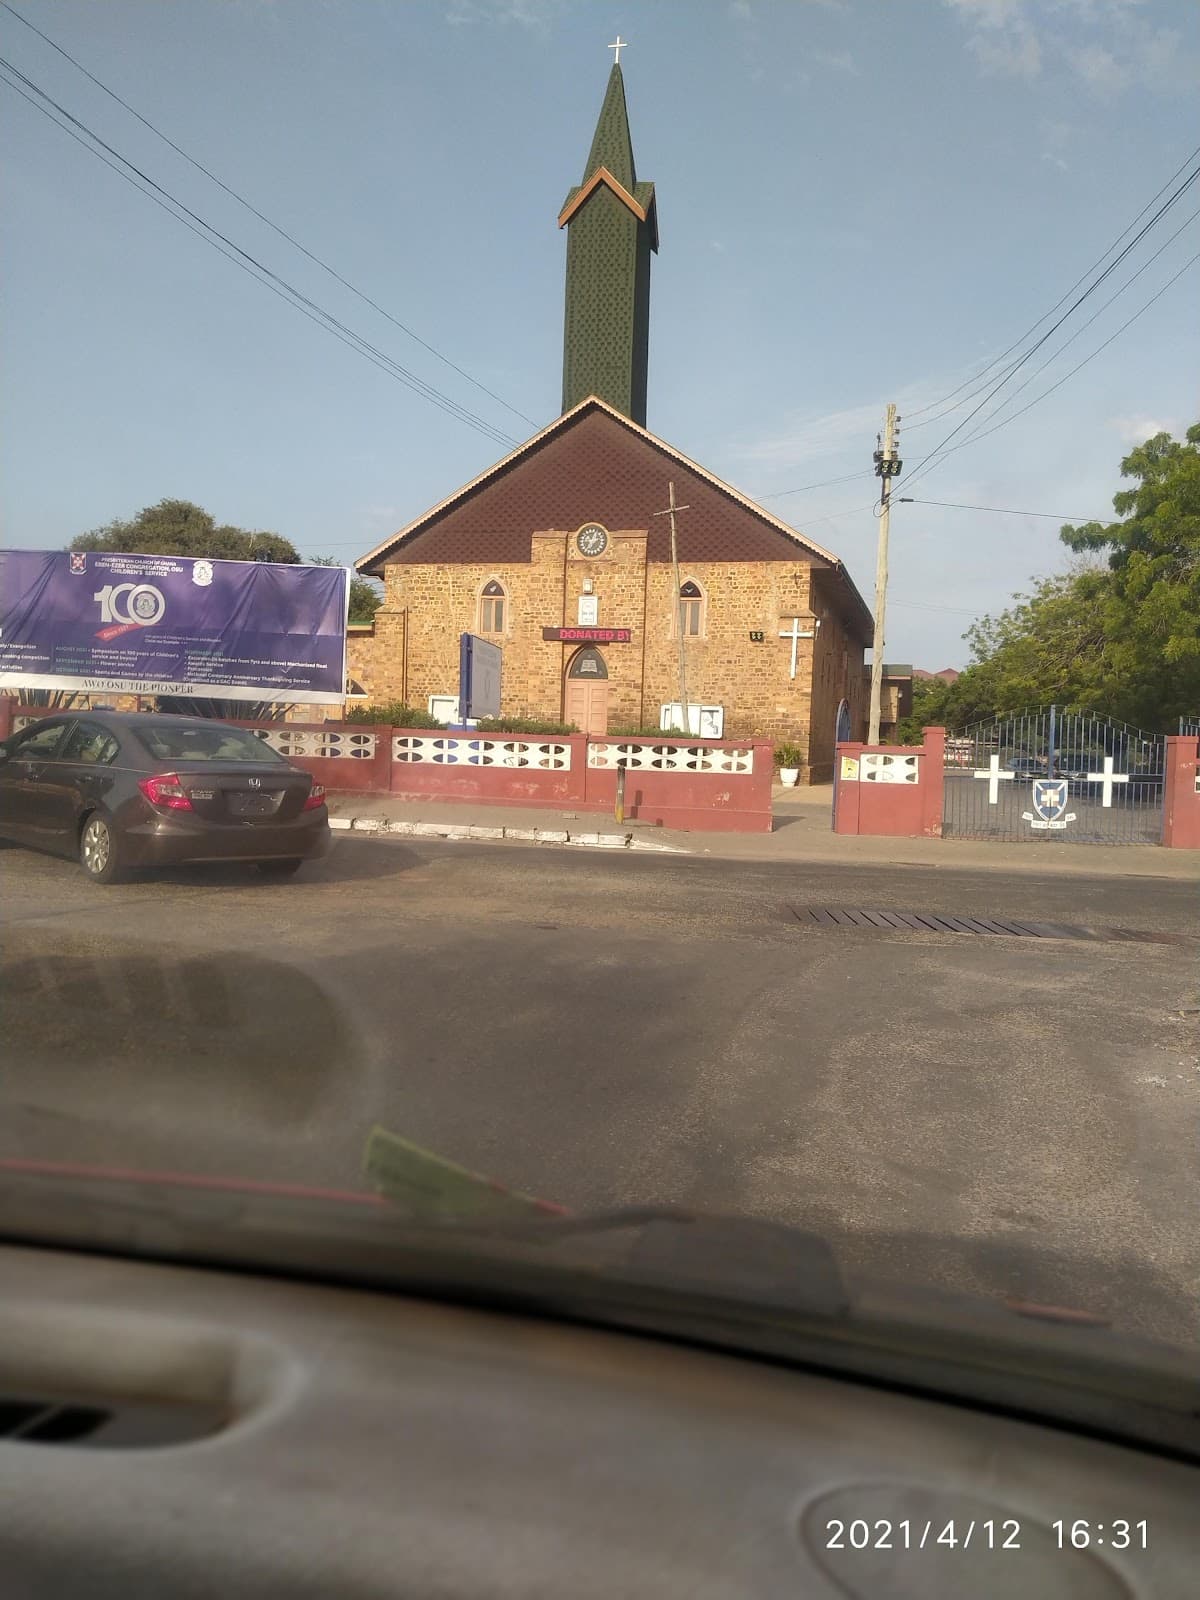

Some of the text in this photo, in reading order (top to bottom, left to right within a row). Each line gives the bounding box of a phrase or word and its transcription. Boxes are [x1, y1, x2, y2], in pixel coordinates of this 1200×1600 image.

[93, 582, 166, 626] 100
[559, 629, 615, 641] DONATED
[128, 681, 150, 691] THE
